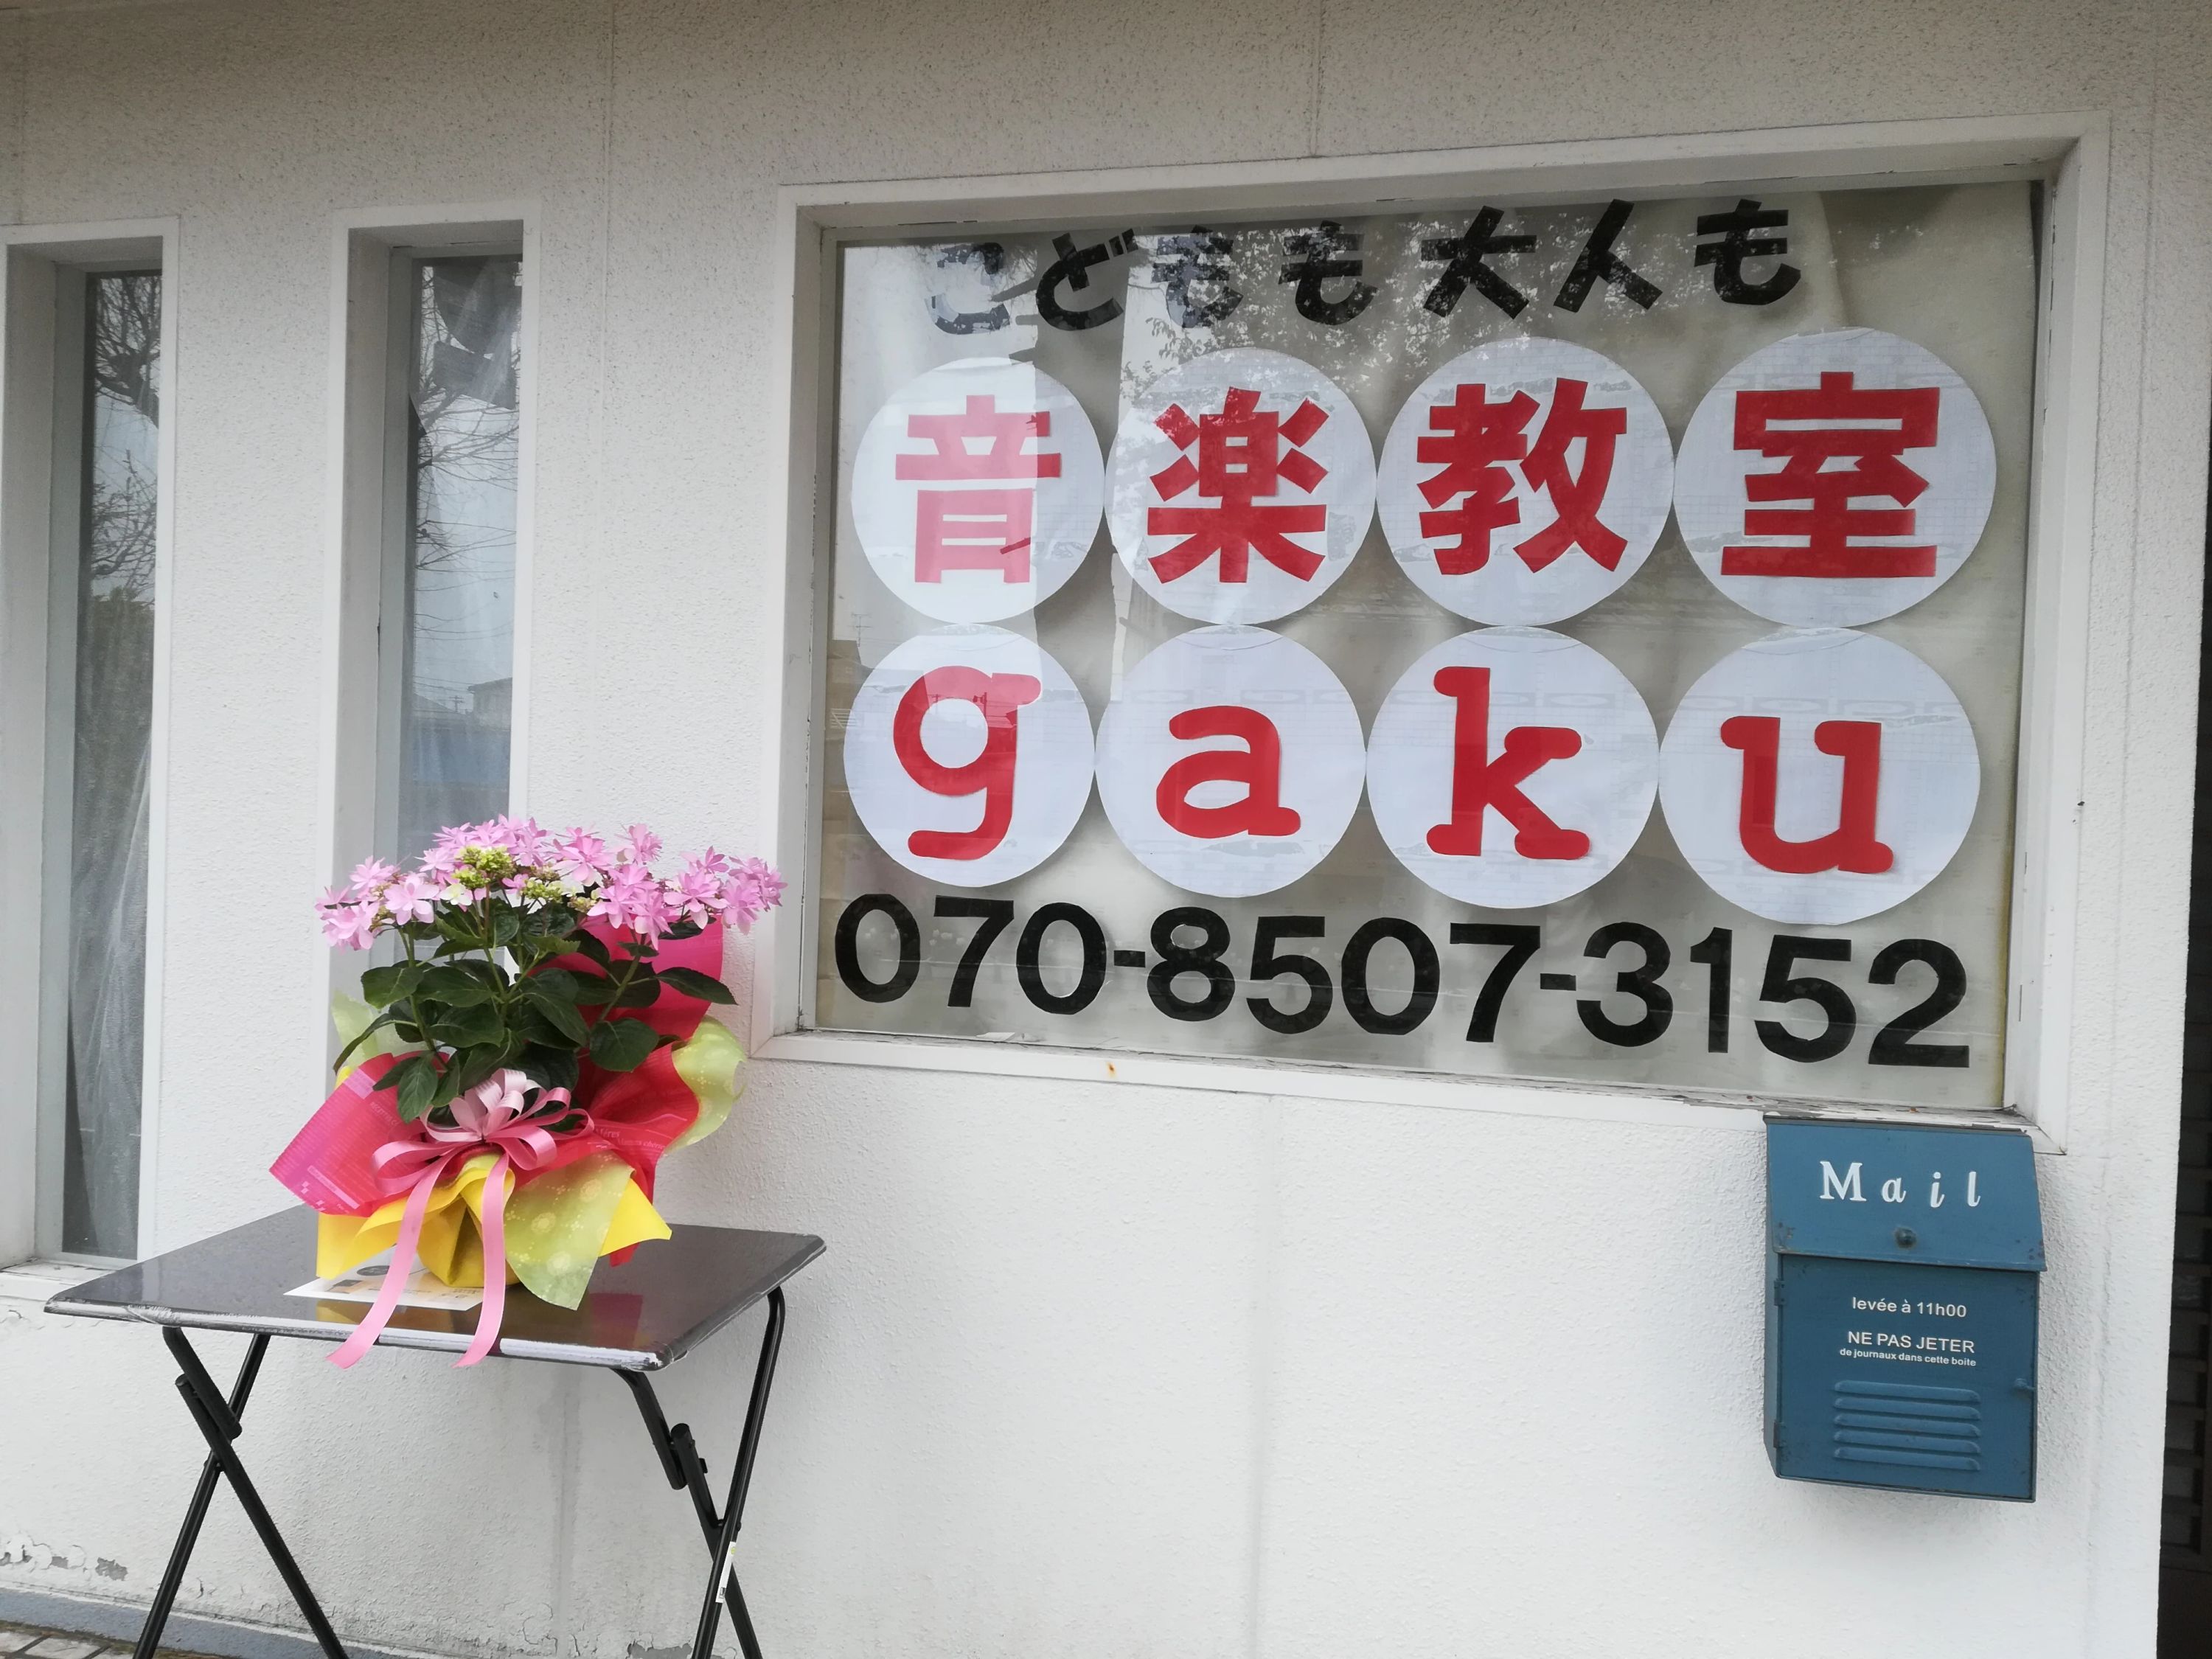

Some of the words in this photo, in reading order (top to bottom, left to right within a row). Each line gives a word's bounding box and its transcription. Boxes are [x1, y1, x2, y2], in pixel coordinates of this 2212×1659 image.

[895, 371, 1941, 584] 音楽教室
[893, 665, 1894, 874] gaku
[835, 893, 1970, 1068] 070-8507-3152
[1819, 1161, 1981, 1208] Mail
[1852, 1297, 1897, 1312] levée
[1901, 1299, 1911, 1313] à
[1917, 1301, 1966, 1318] 11h00
[1840, 1348, 1852, 1356] de
[1853, 1349, 1896, 1360] journaux
[1899, 1352, 1922, 1362] dans
[1924, 1354, 1949, 1364] cette
[1848, 1331, 1872, 1345] NE
[1877, 1333, 1912, 1348] PAS
[1916, 1337, 1975, 1354] JETER
